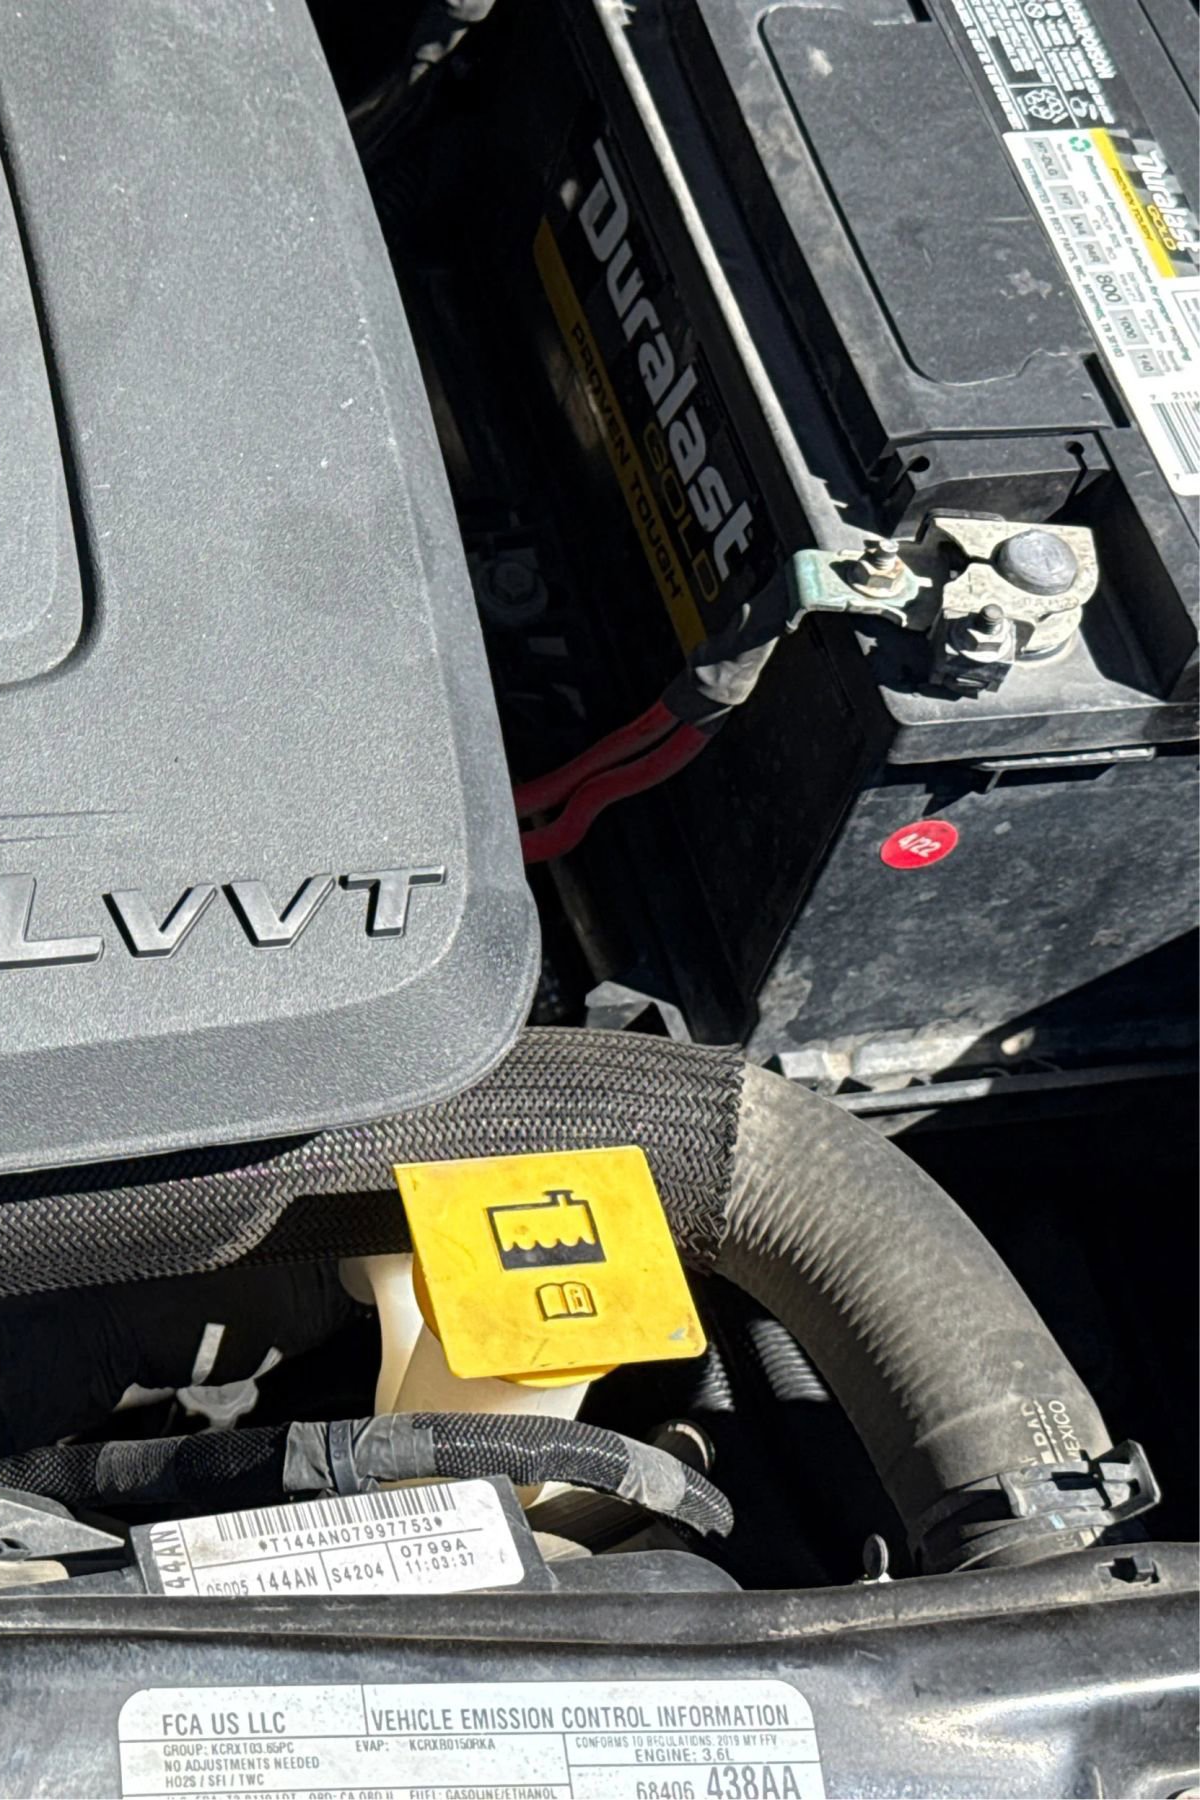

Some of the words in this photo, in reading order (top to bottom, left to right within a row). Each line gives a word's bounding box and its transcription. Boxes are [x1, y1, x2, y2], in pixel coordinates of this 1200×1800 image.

[1059, 192, 1073, 206] H7
[1132, 150, 1200, 252] Duralast
[1146, 205, 1177, 251] GOLD
[1096, 274, 1122, 303] 800
[1118, 315, 1138, 340] 1000
[578, 138, 753, 582] Duralast
[1137, 354, 1154, 372] 140
[570, 322, 631, 467] PROVEN
[628, 470, 681, 600] TOUGH
[642, 422, 719, 603] GOLD
[106, 866, 447, 959] VVT
[401, 1538, 467, 1558] 0799A
[331, 1562, 384, 1583] S4204
[405, 1552, 475, 1575] 11:03:37
[256, 1567, 318, 1592] 144AN
[162, 1713, 203, 1736] FCA
[211, 1712, 240, 1735] US
[248, 1711, 286, 1734] LLC
[371, 1707, 453, 1731] VEHICLE
[460, 1707, 554, 1730] EMISSION
[562, 1706, 651, 1729] CONTROL
[657, 1704, 790, 1727] INFORMATION
[163, 1743, 208, 1757] GROUP:
[355, 1739, 389, 1752] EVAP:
[576, 1735, 629, 1748] CONFORMS
[717, 1735, 740, 1746] 2019
[743, 1734, 756, 1746] MY
[164, 1759, 181, 1772] NO
[185, 1758, 270, 1771] ADJUSTMENTS
[274, 1756, 319, 1769] NEEDED
[635, 1749, 697, 1763] ENGINE:
[702, 1748, 734, 1762] 3.6L
[208, 1774, 227, 1787] SFI
[240, 1773, 265, 1786] TWC
[636, 1781, 695, 1800] 68406
[706, 1765, 802, 1800] 438AA
[445, 1787, 558, 1800] GASOLINE/ETHANOL
